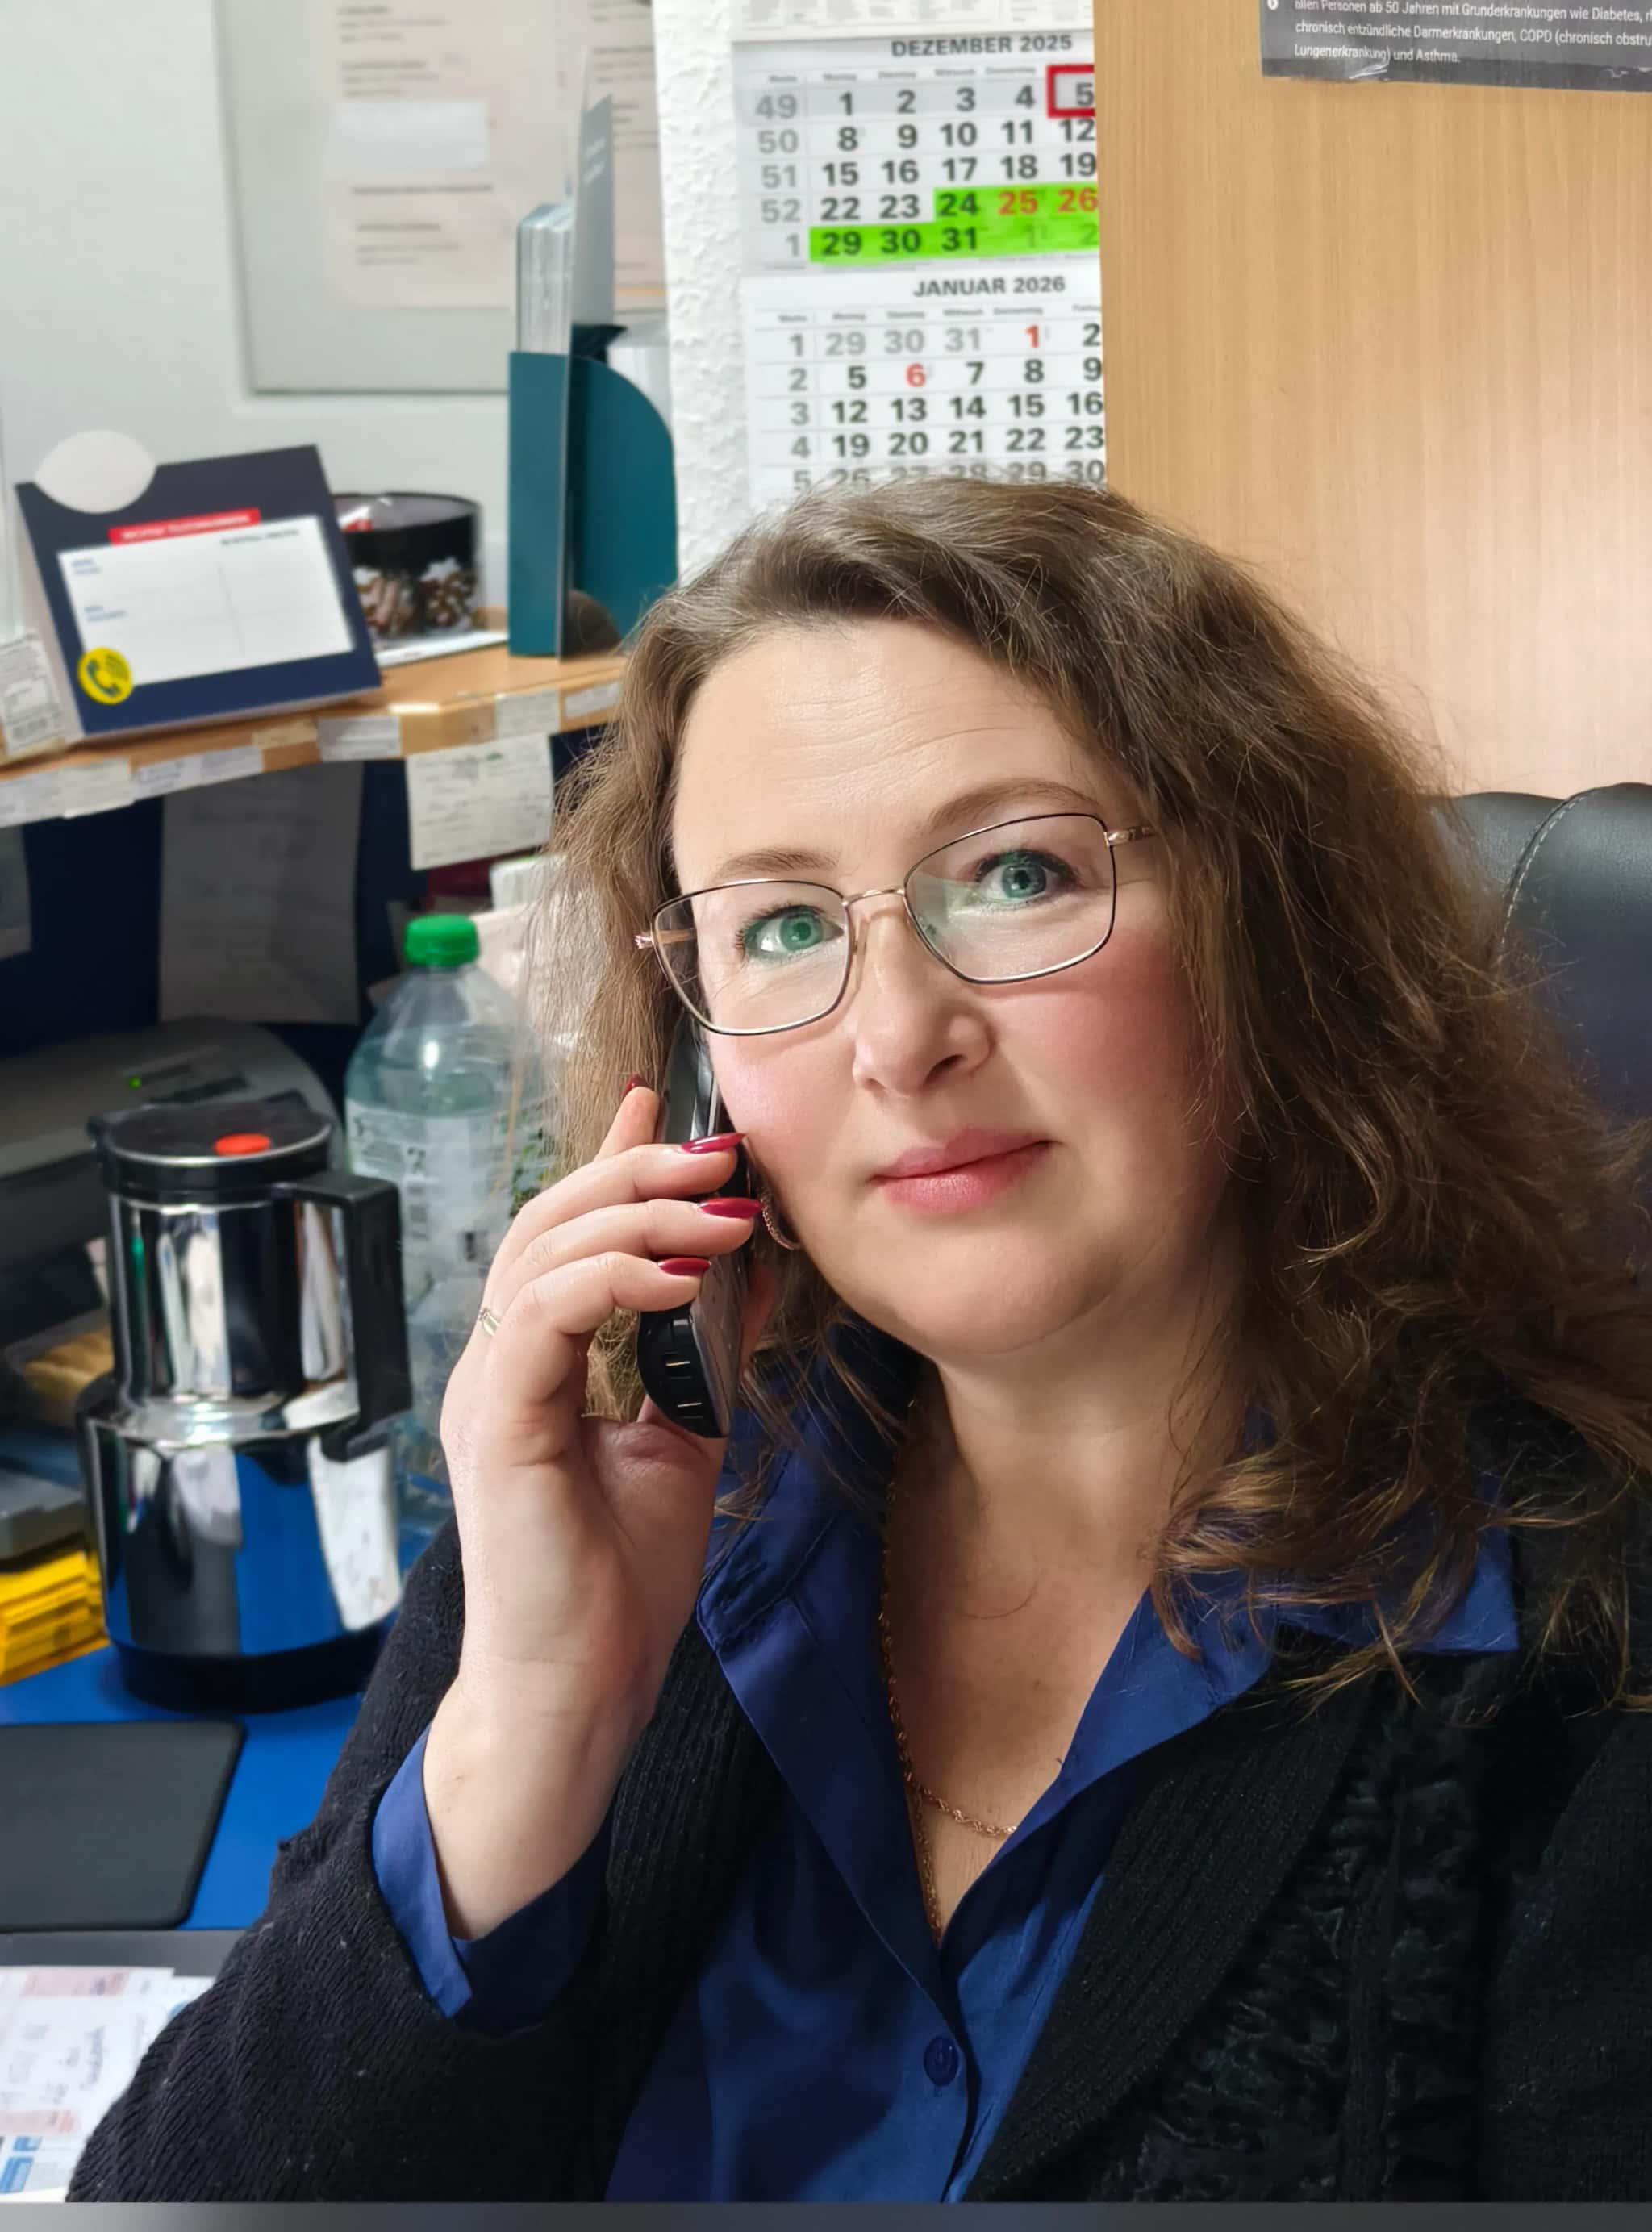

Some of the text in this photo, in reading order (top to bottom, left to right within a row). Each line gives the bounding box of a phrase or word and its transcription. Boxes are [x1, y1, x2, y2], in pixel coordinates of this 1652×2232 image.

[1322, 0, 1367, 14] Personen
[1369, 1, 1383, 13] ab
[1385, 2, 1400, 14] 50
[1402, 2, 1439, 15] Jahren
[1441, 3, 1459, 15] mit
[1462, 3, 1567, 22] Grunderkrankungen
[1570, 8, 1589, 19] wie
[1592, 7, 1643, 23] Diabetes,
[890, 33, 1074, 58] DEZEMBER 2025
[1295, 19, 1345, 35] chronisch
[1520, 29, 1552, 42] COPD
[1555, 29, 1612, 45] (chronisch
[1393, 48, 1413, 60] und
[755, 82, 1094, 119] 49 1 2 3 4 5
[757, 118, 1095, 155] 50 8 9 10 11 12
[761, 152, 1096, 190] 51 15 16 17 18 19
[761, 187, 1098, 224] 52 22 23 24 25 26
[789, 233, 800, 257] 1
[821, 231, 863, 257] 29
[879, 229, 921, 254] 30
[940, 225, 978, 252] 31
[913, 276, 1066, 298] JANUAR 2026
[790, 323, 1101, 357] 1 29 30 31 1 2
[789, 357, 1102, 392] 2 5 6 7 8 9
[791, 392, 1103, 427] 3 12 13 14 15 16
[791, 426, 1104, 459] 4 19 20 21 22 23
[792, 469, 811, 491] 5
[1065, 460, 1106, 484] 30
